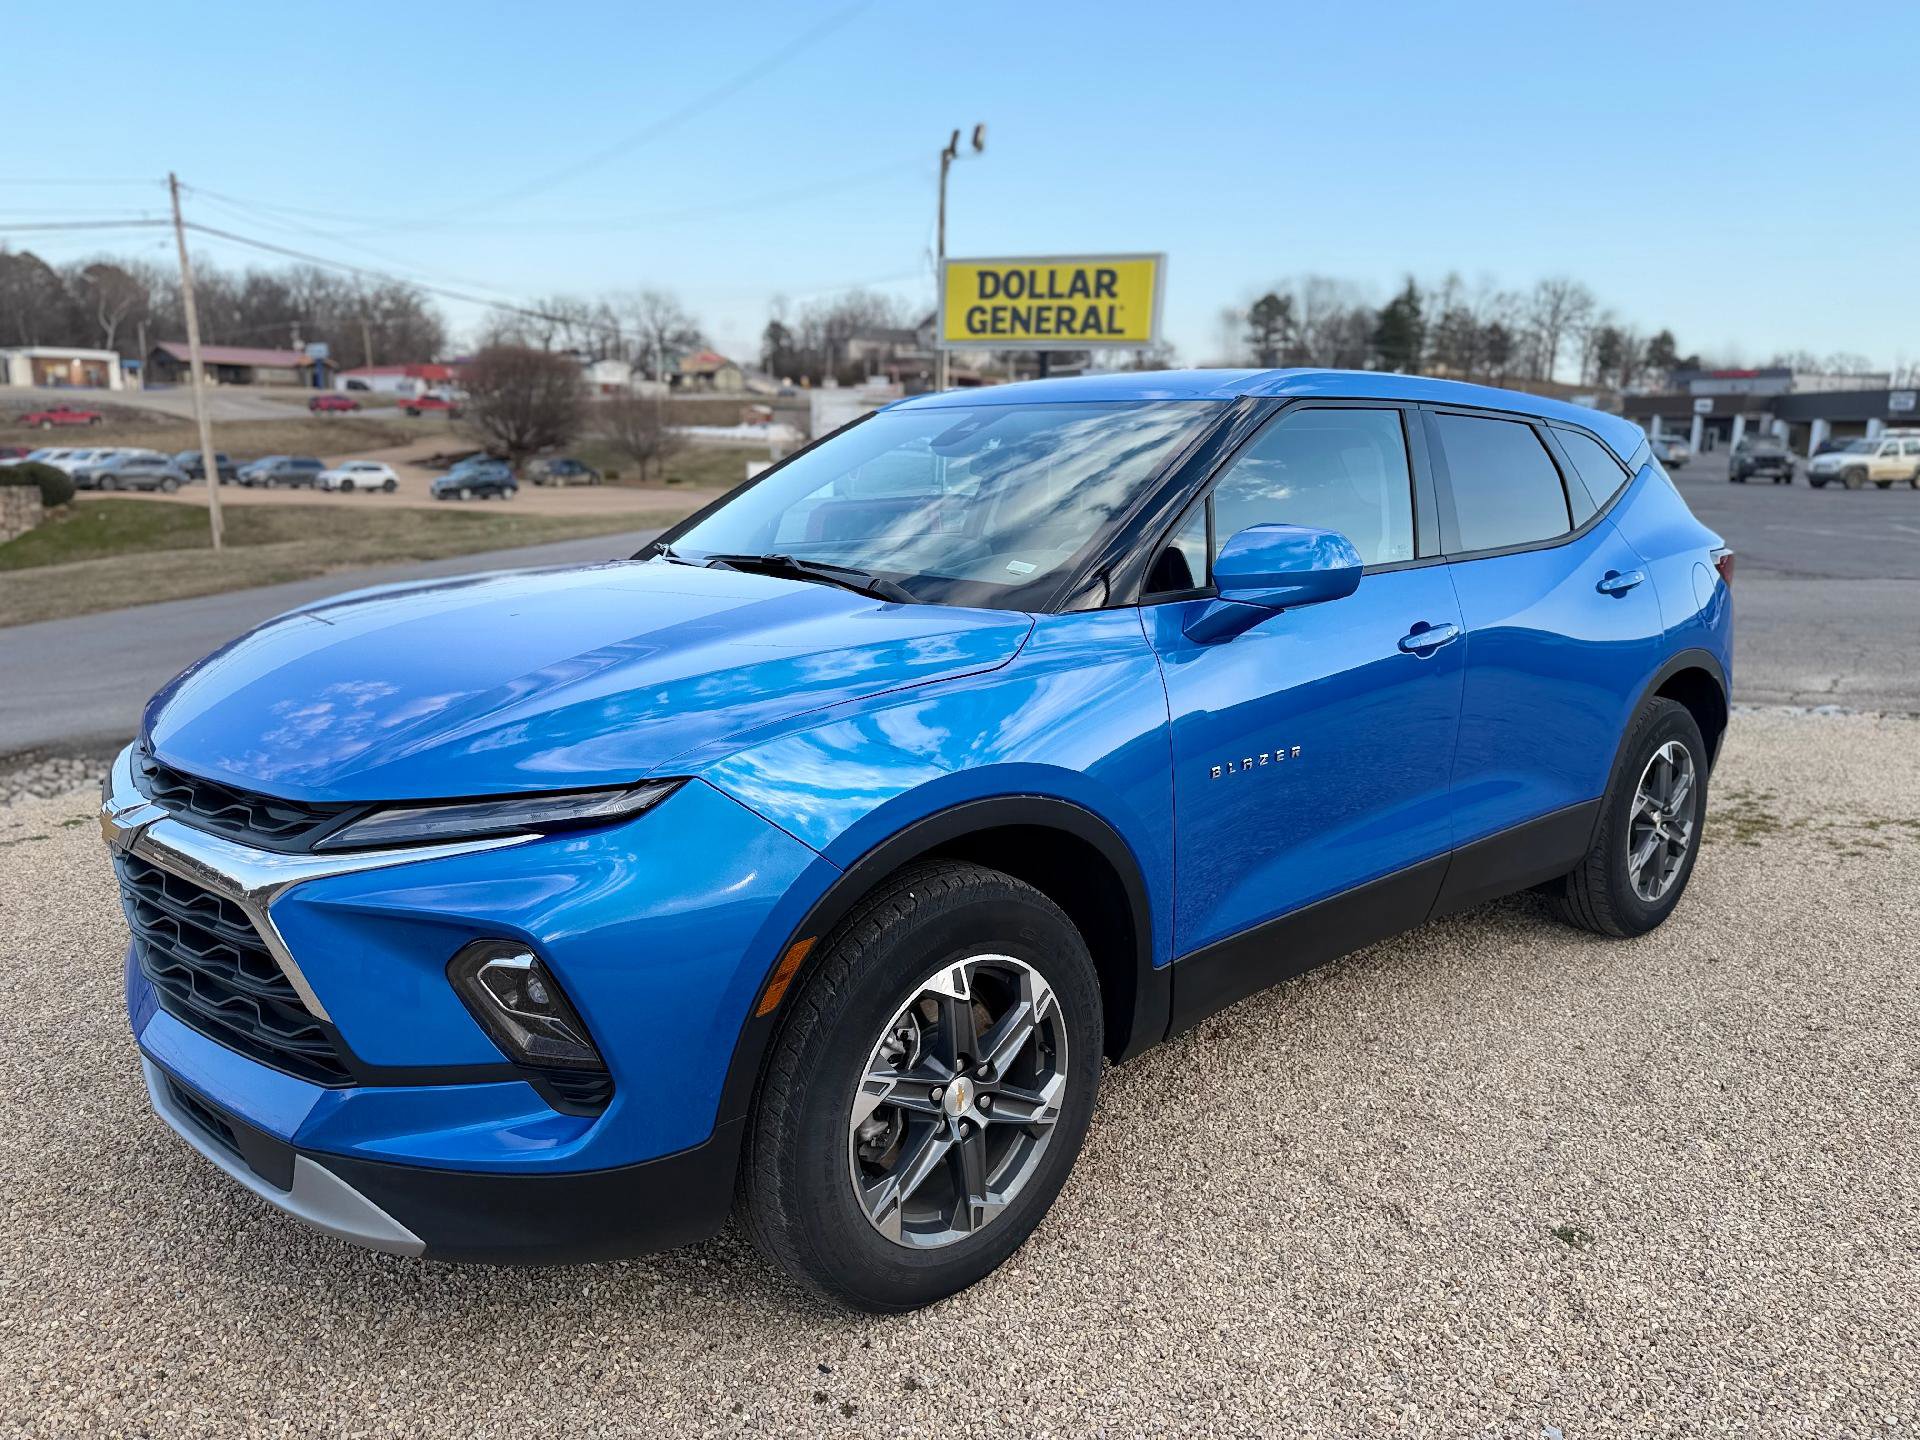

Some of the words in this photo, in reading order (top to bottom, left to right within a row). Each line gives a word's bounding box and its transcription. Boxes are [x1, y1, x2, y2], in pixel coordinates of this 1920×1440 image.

[977, 269, 1118, 299] DOLLAR
[966, 305, 1125, 335] GENERAL
[1210, 745, 1301, 780] BLAZER
